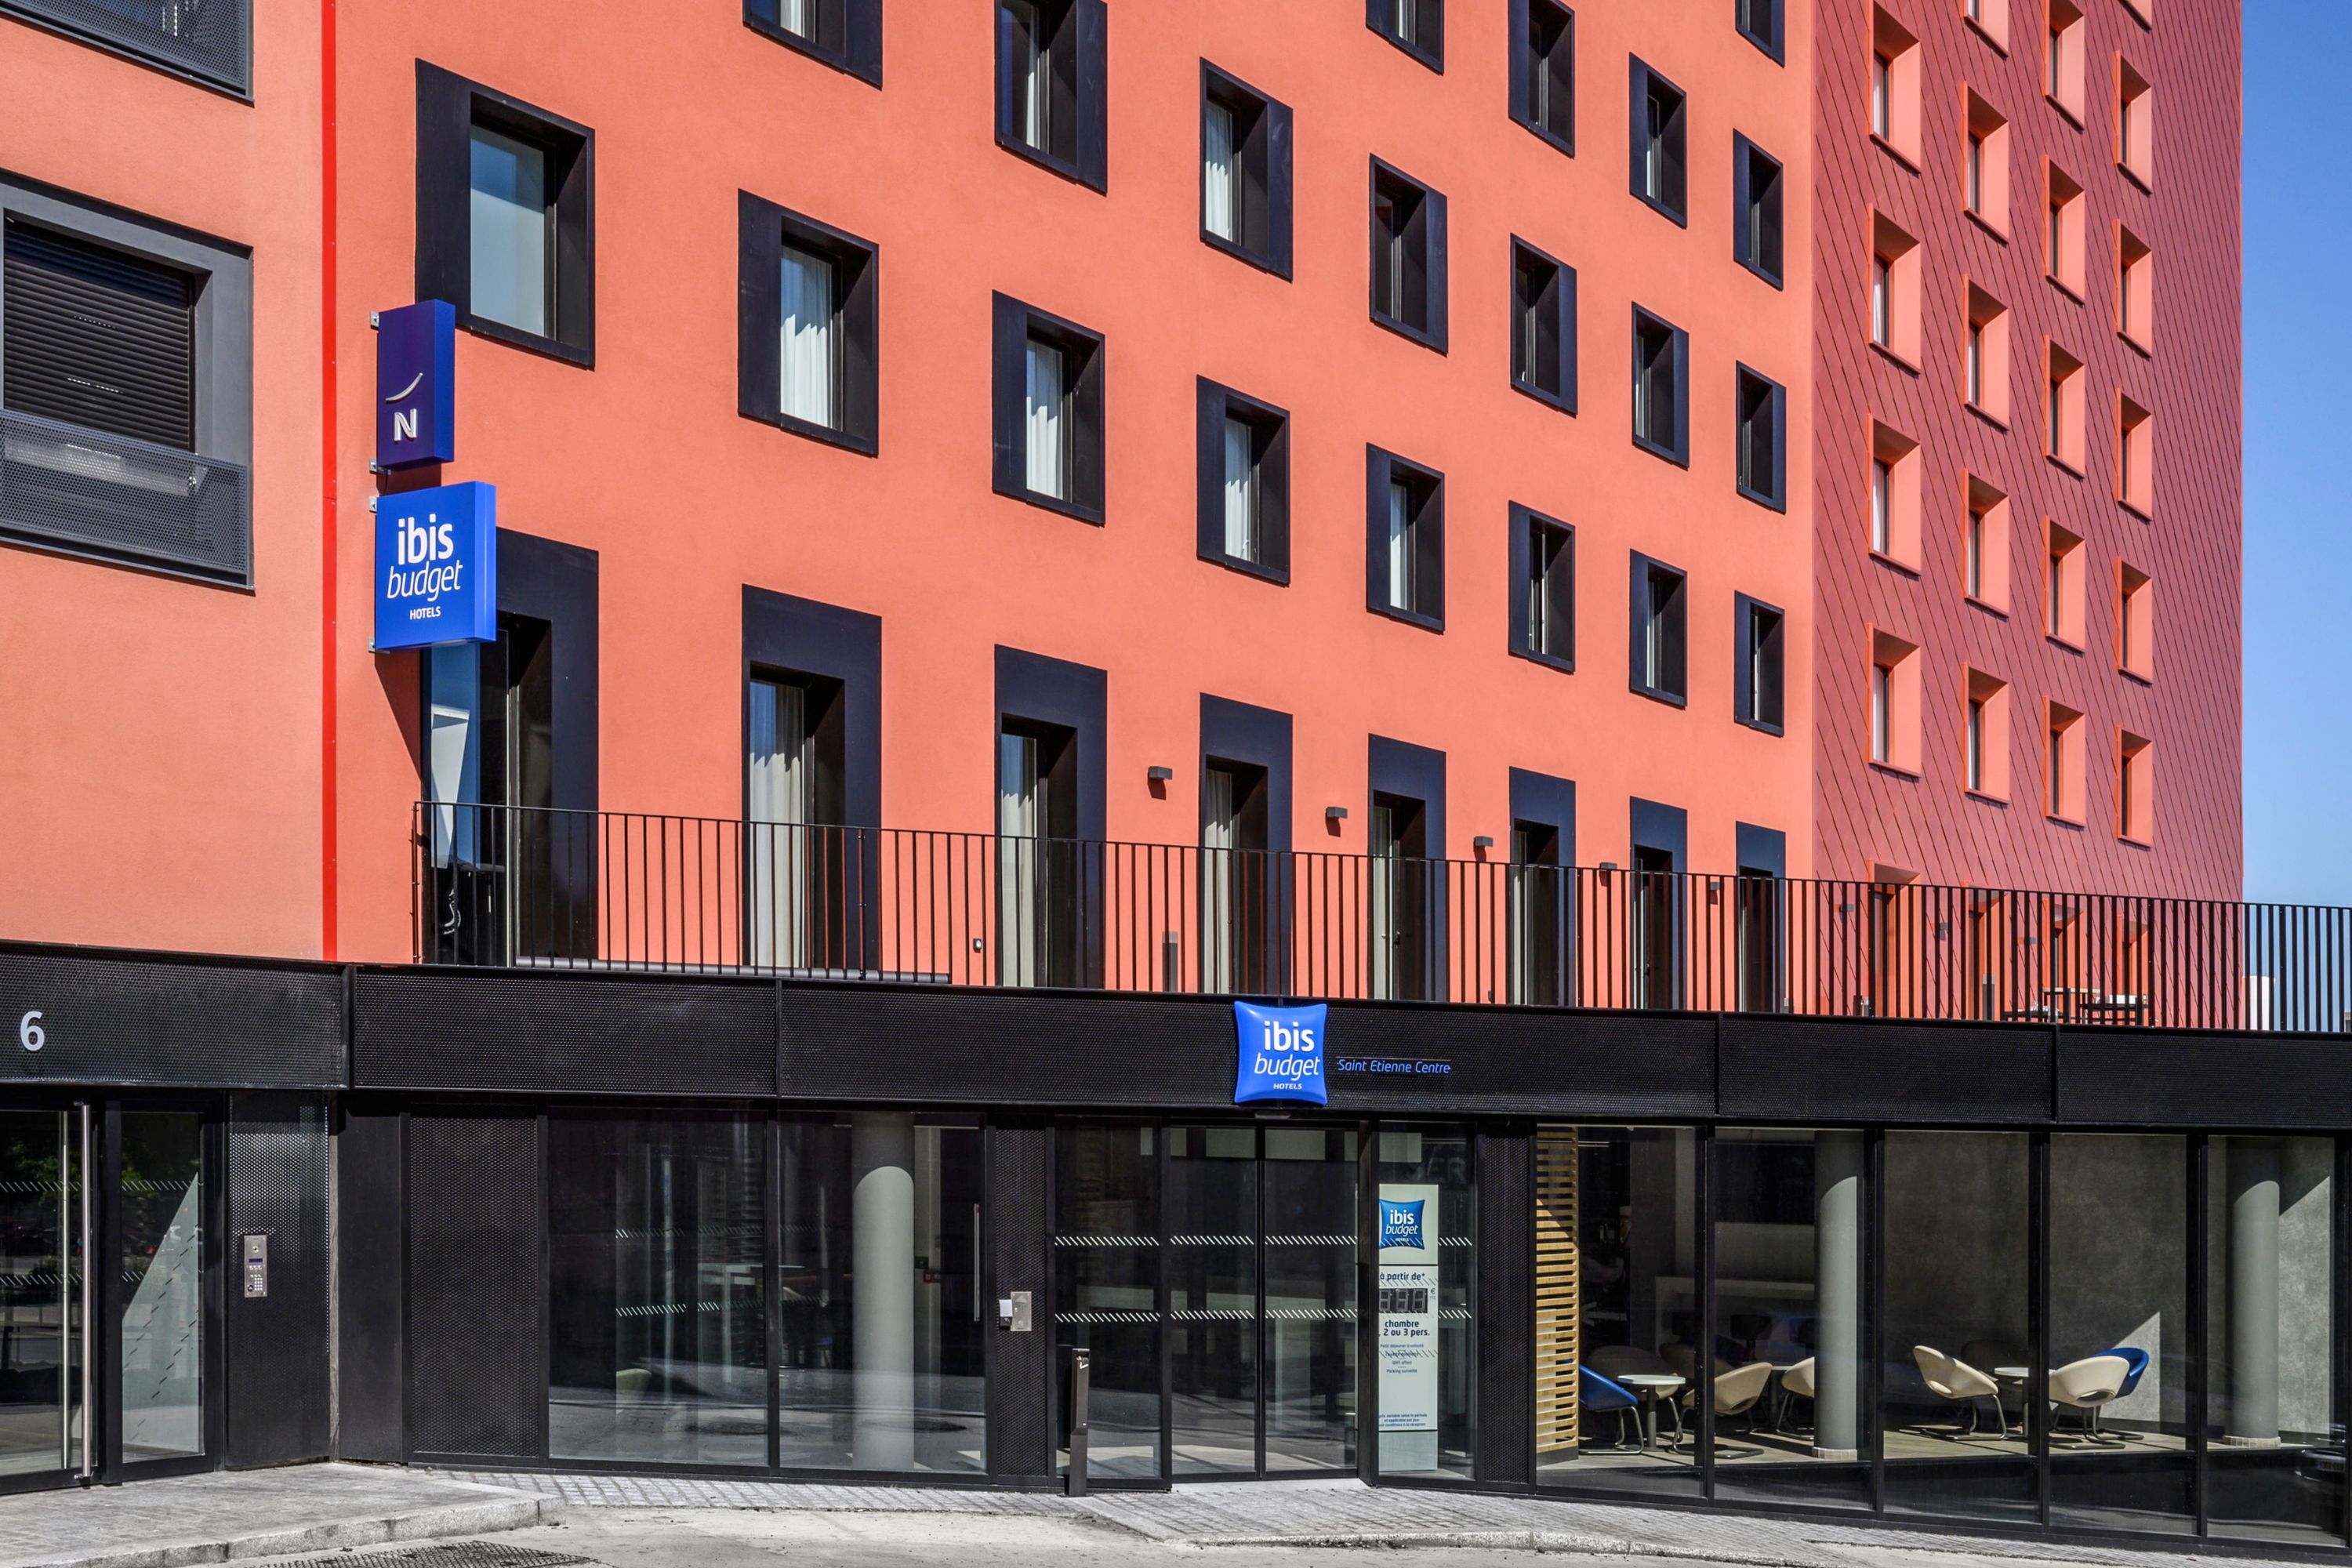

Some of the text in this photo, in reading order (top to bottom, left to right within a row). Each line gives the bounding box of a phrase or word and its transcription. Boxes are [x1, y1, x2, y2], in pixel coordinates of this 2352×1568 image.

[394, 408, 417, 441] N
[397, 514, 454, 565] ibis
[387, 560, 463, 602] budget
[409, 605, 441, 621] HOTELS
[20, 1011, 45, 1051] 6
[1264, 1020, 1315, 1052] ibis
[1254, 1052, 1320, 1081] budget
[1338, 1059, 1450, 1074] Saint Etienne Centre
[1389, 1209, 1414, 1225] ibis
[1385, 1223, 1418, 1237] budget
[1387, 1272, 1409, 1282] partir
[1385, 1319, 1420, 1328] chambre
